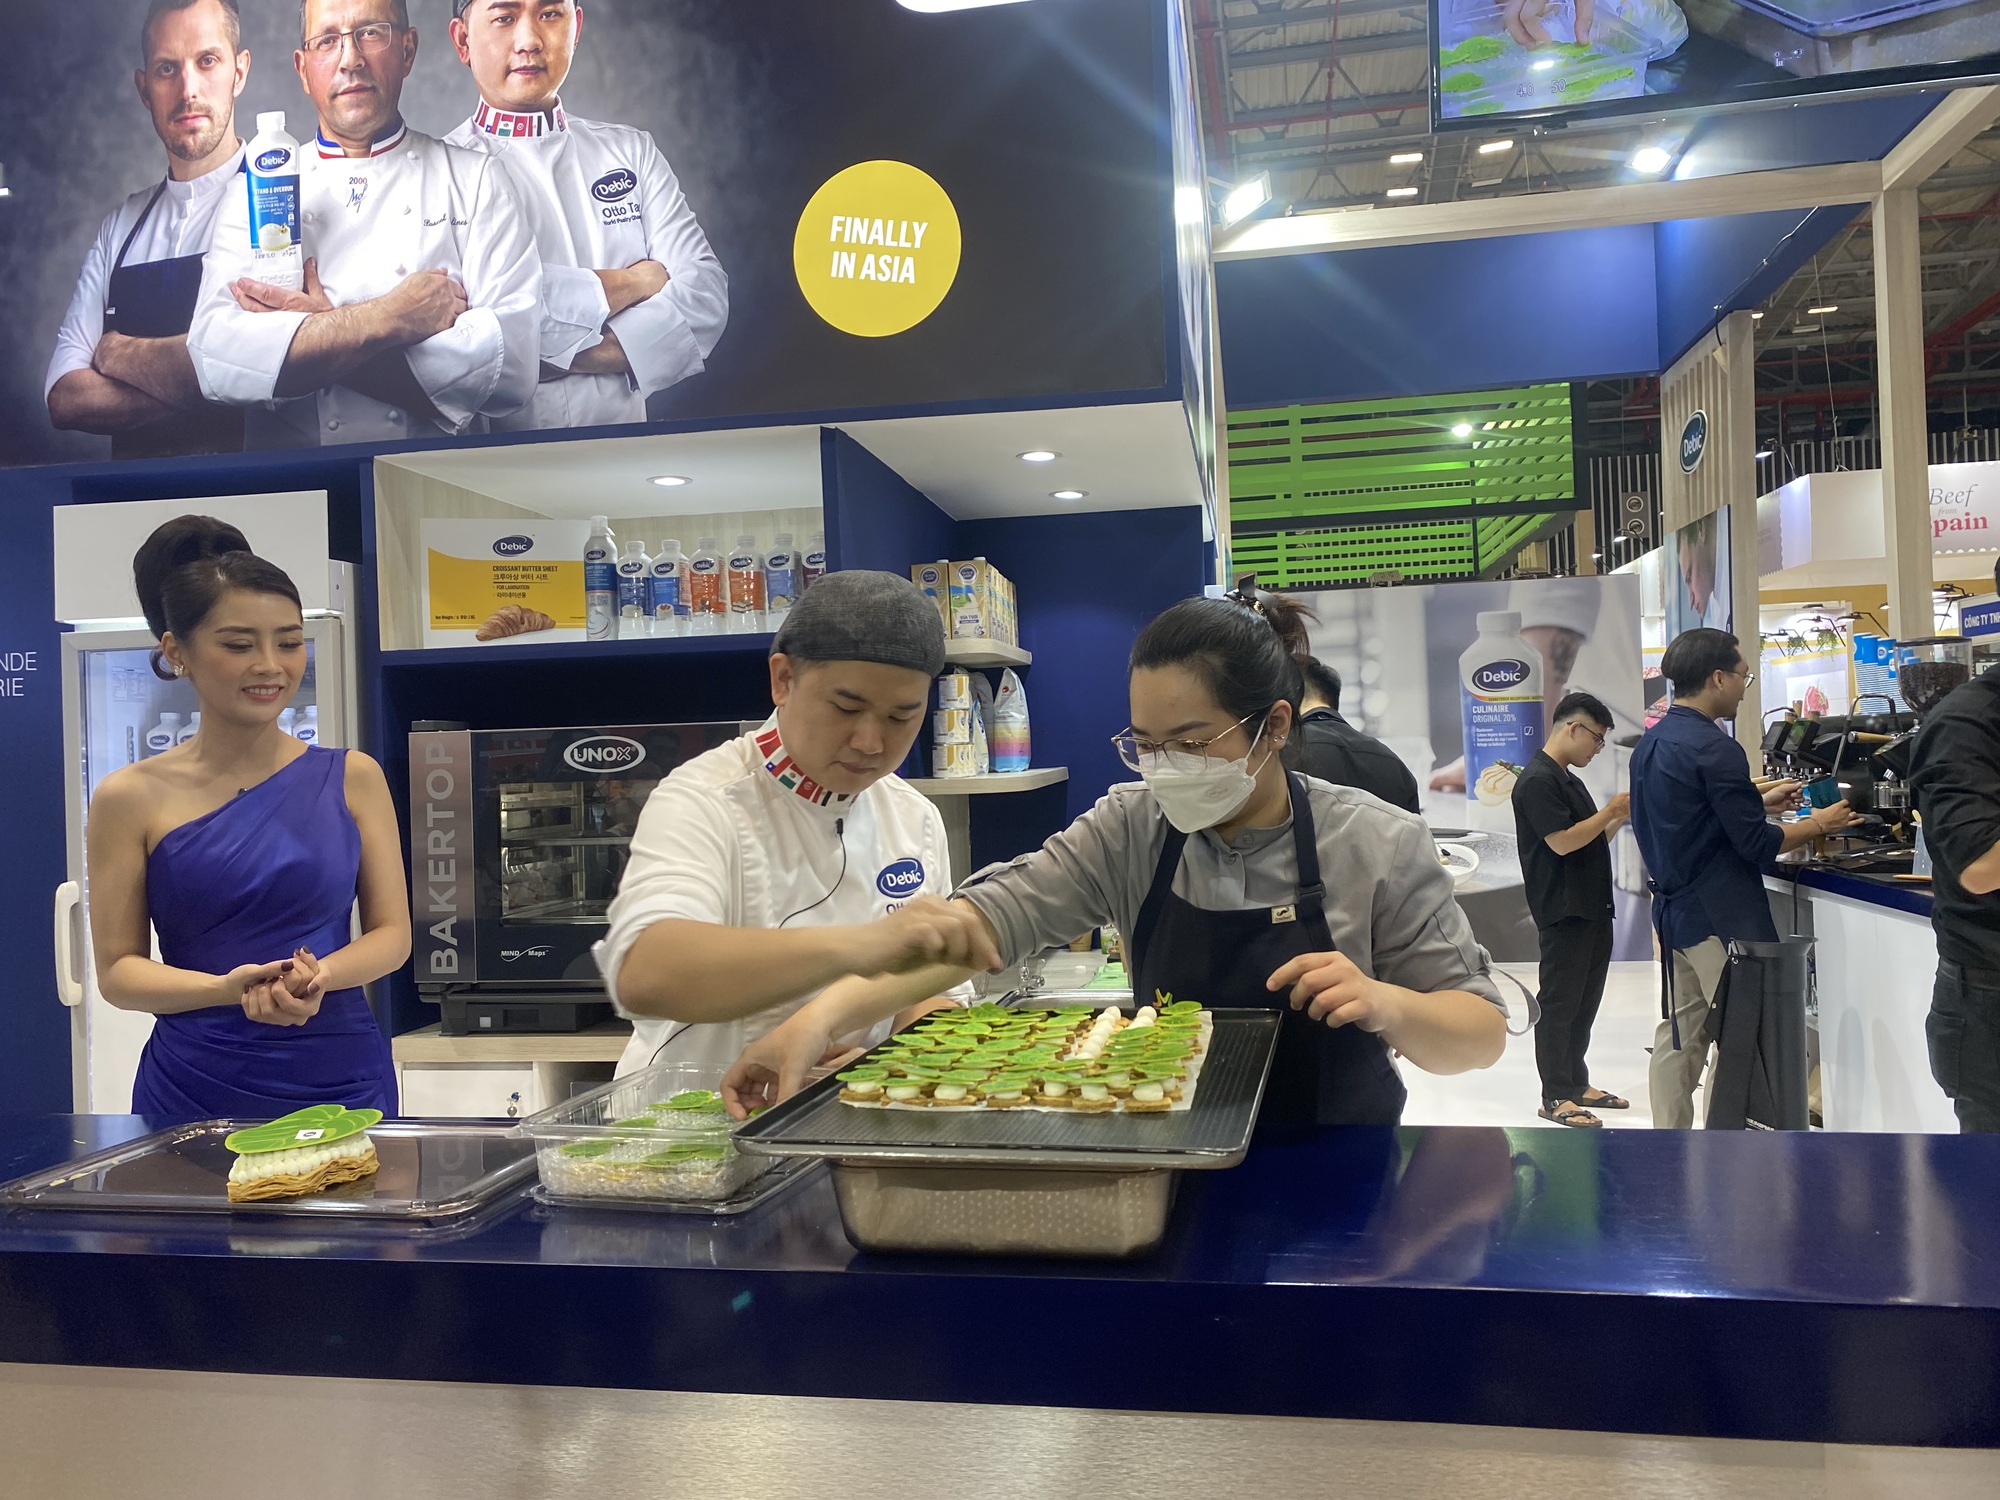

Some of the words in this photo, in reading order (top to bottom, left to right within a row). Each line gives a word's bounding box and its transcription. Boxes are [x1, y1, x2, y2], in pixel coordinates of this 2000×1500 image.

[1551, 79, 1567, 93] 50
[261, 156, 285, 166] Debic
[597, 178, 634, 195] Debic
[602, 205, 627, 218] Otto
[627, 202, 641, 213] Ta
[829, 215, 928, 249] FINALLY
[830, 251, 856, 279] IN
[859, 253, 916, 284] ASIA
[1683, 433, 1702, 458] Debic
[1929, 484, 1979, 507] Beef
[1937, 507, 1957, 516] from
[1931, 512, 1989, 538] pain
[500, 542, 527, 551] Debic
[520, 573, 534, 581] 버터
[1964, 614, 1980, 628] CÔNG
[1980, 613, 1988, 625] TY
[1482, 670, 1521, 683] Debic
[1472, 704, 1509, 714] CULINAIRE
[1472, 714, 1502, 723] ORIGINAL
[1503, 713, 1517, 722] 20%
[573, 746, 632, 762] UNOX
[425, 741, 459, 974] BAKERTOP
[885, 870, 922, 887] Debic
